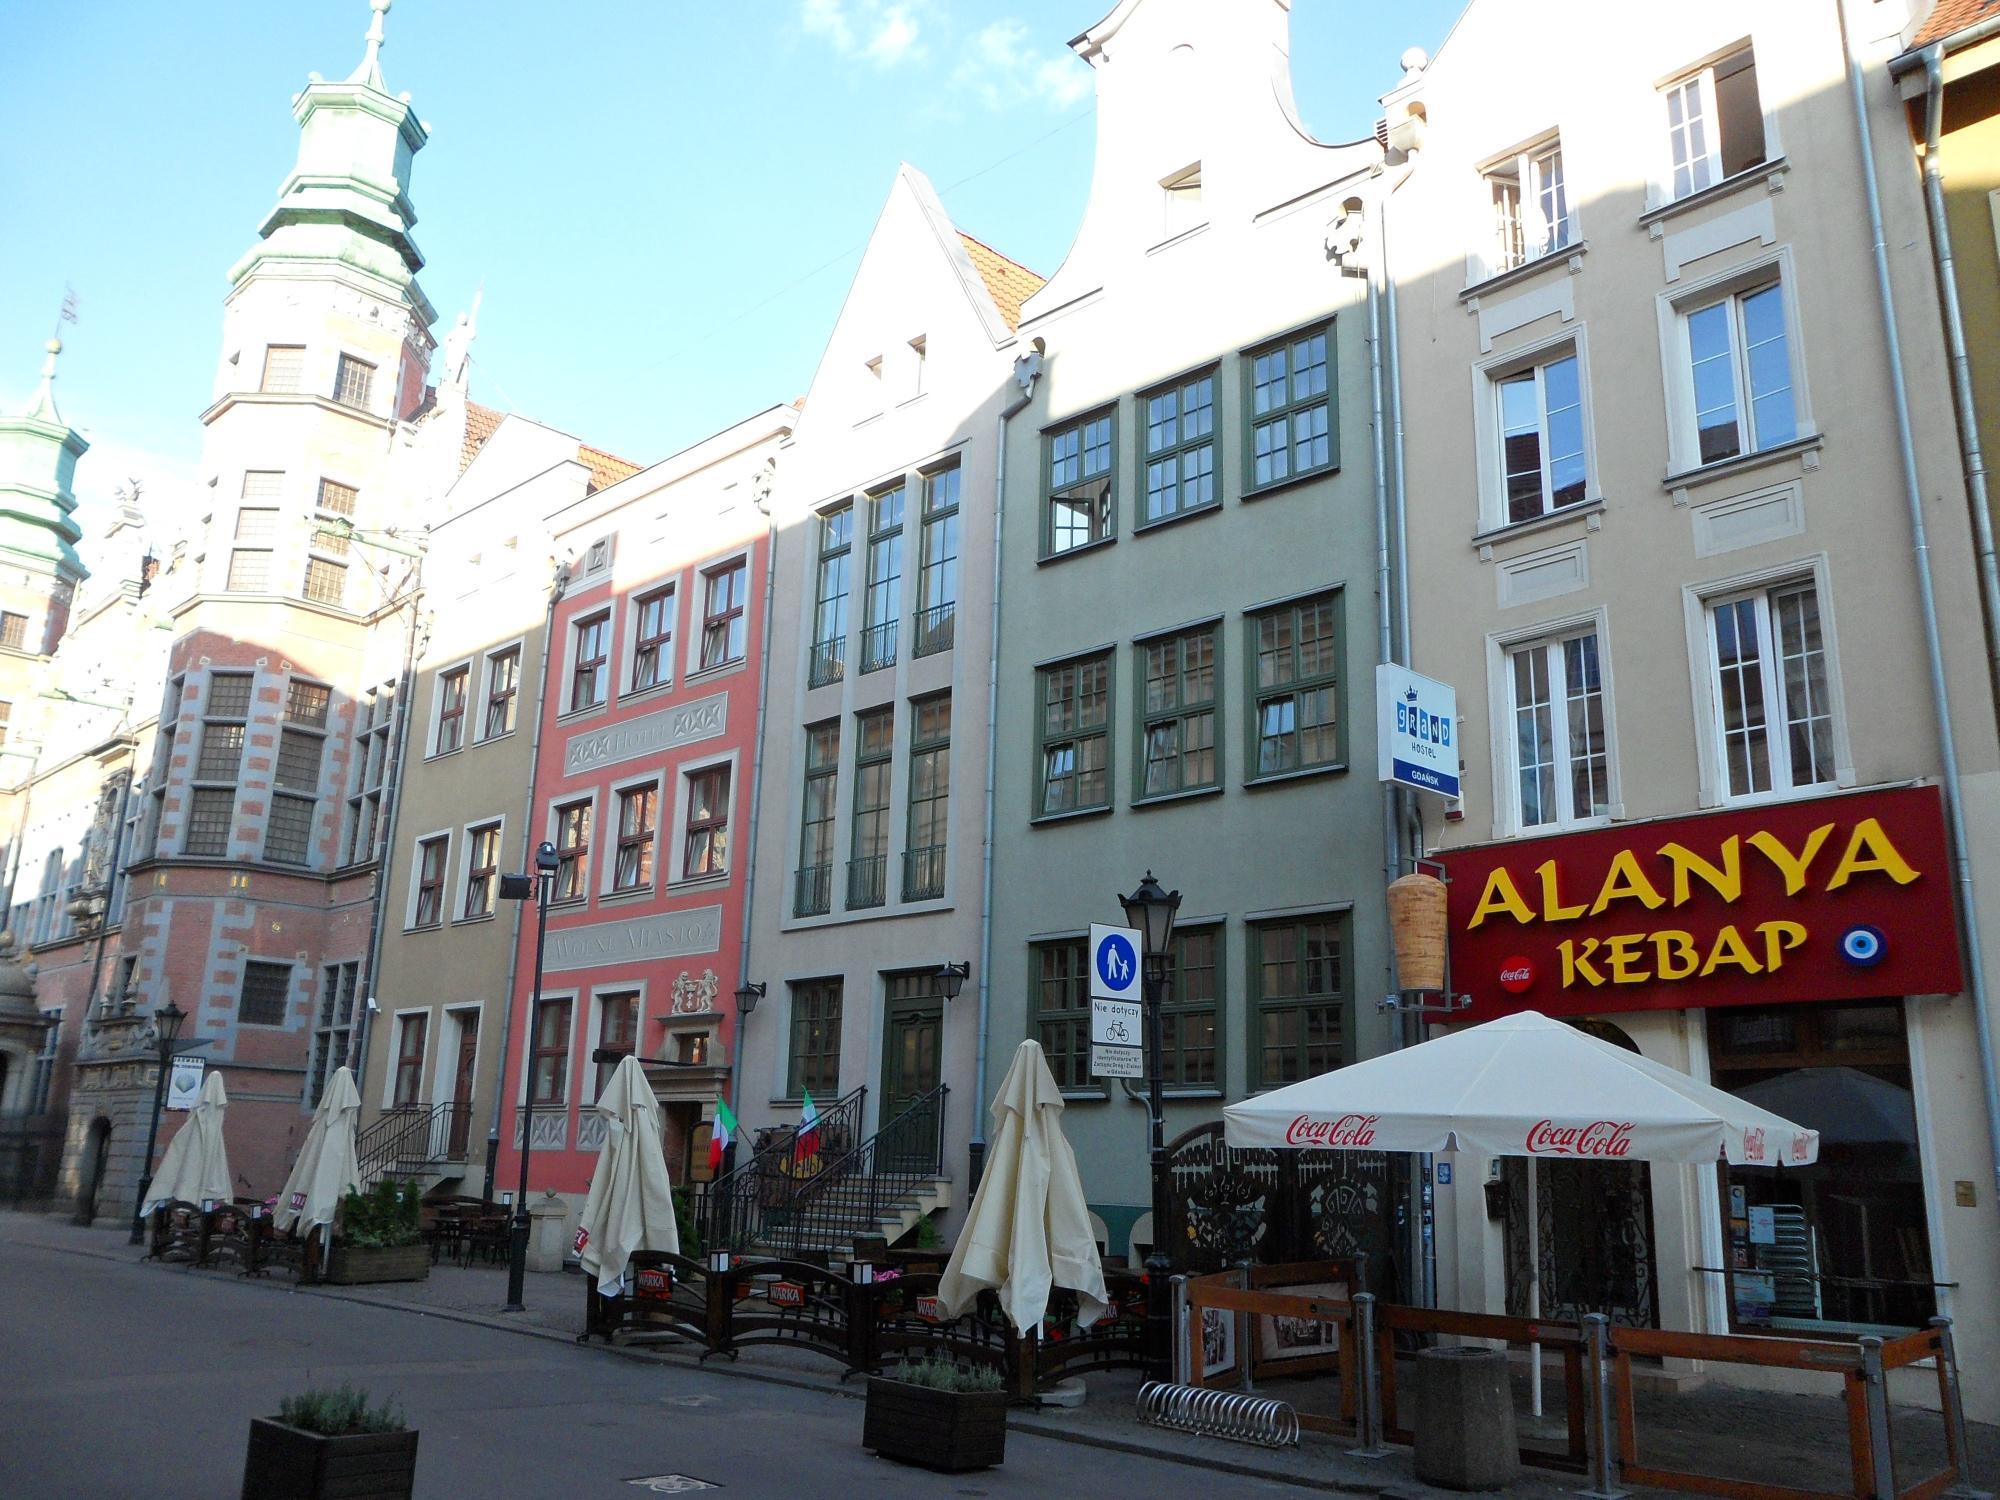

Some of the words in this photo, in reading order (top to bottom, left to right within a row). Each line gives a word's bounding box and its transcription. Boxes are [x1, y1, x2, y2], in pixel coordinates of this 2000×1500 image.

[1411, 769, 1440, 786] GDAŃSK
[1466, 817, 1921, 930] ALANYA
[1557, 920, 1808, 989] KEBAP
[1094, 1002, 1107, 1013] Nie
[1111, 1003, 1139, 1018] dotyczy
[1285, 1114, 1382, 1146] Coca-Cola
[1525, 1119, 1639, 1157] Coca-Cola
[638, 1275, 665, 1289] WARKA
[770, 1285, 800, 1302] WARKA
[917, 1300, 937, 1316] WAR
